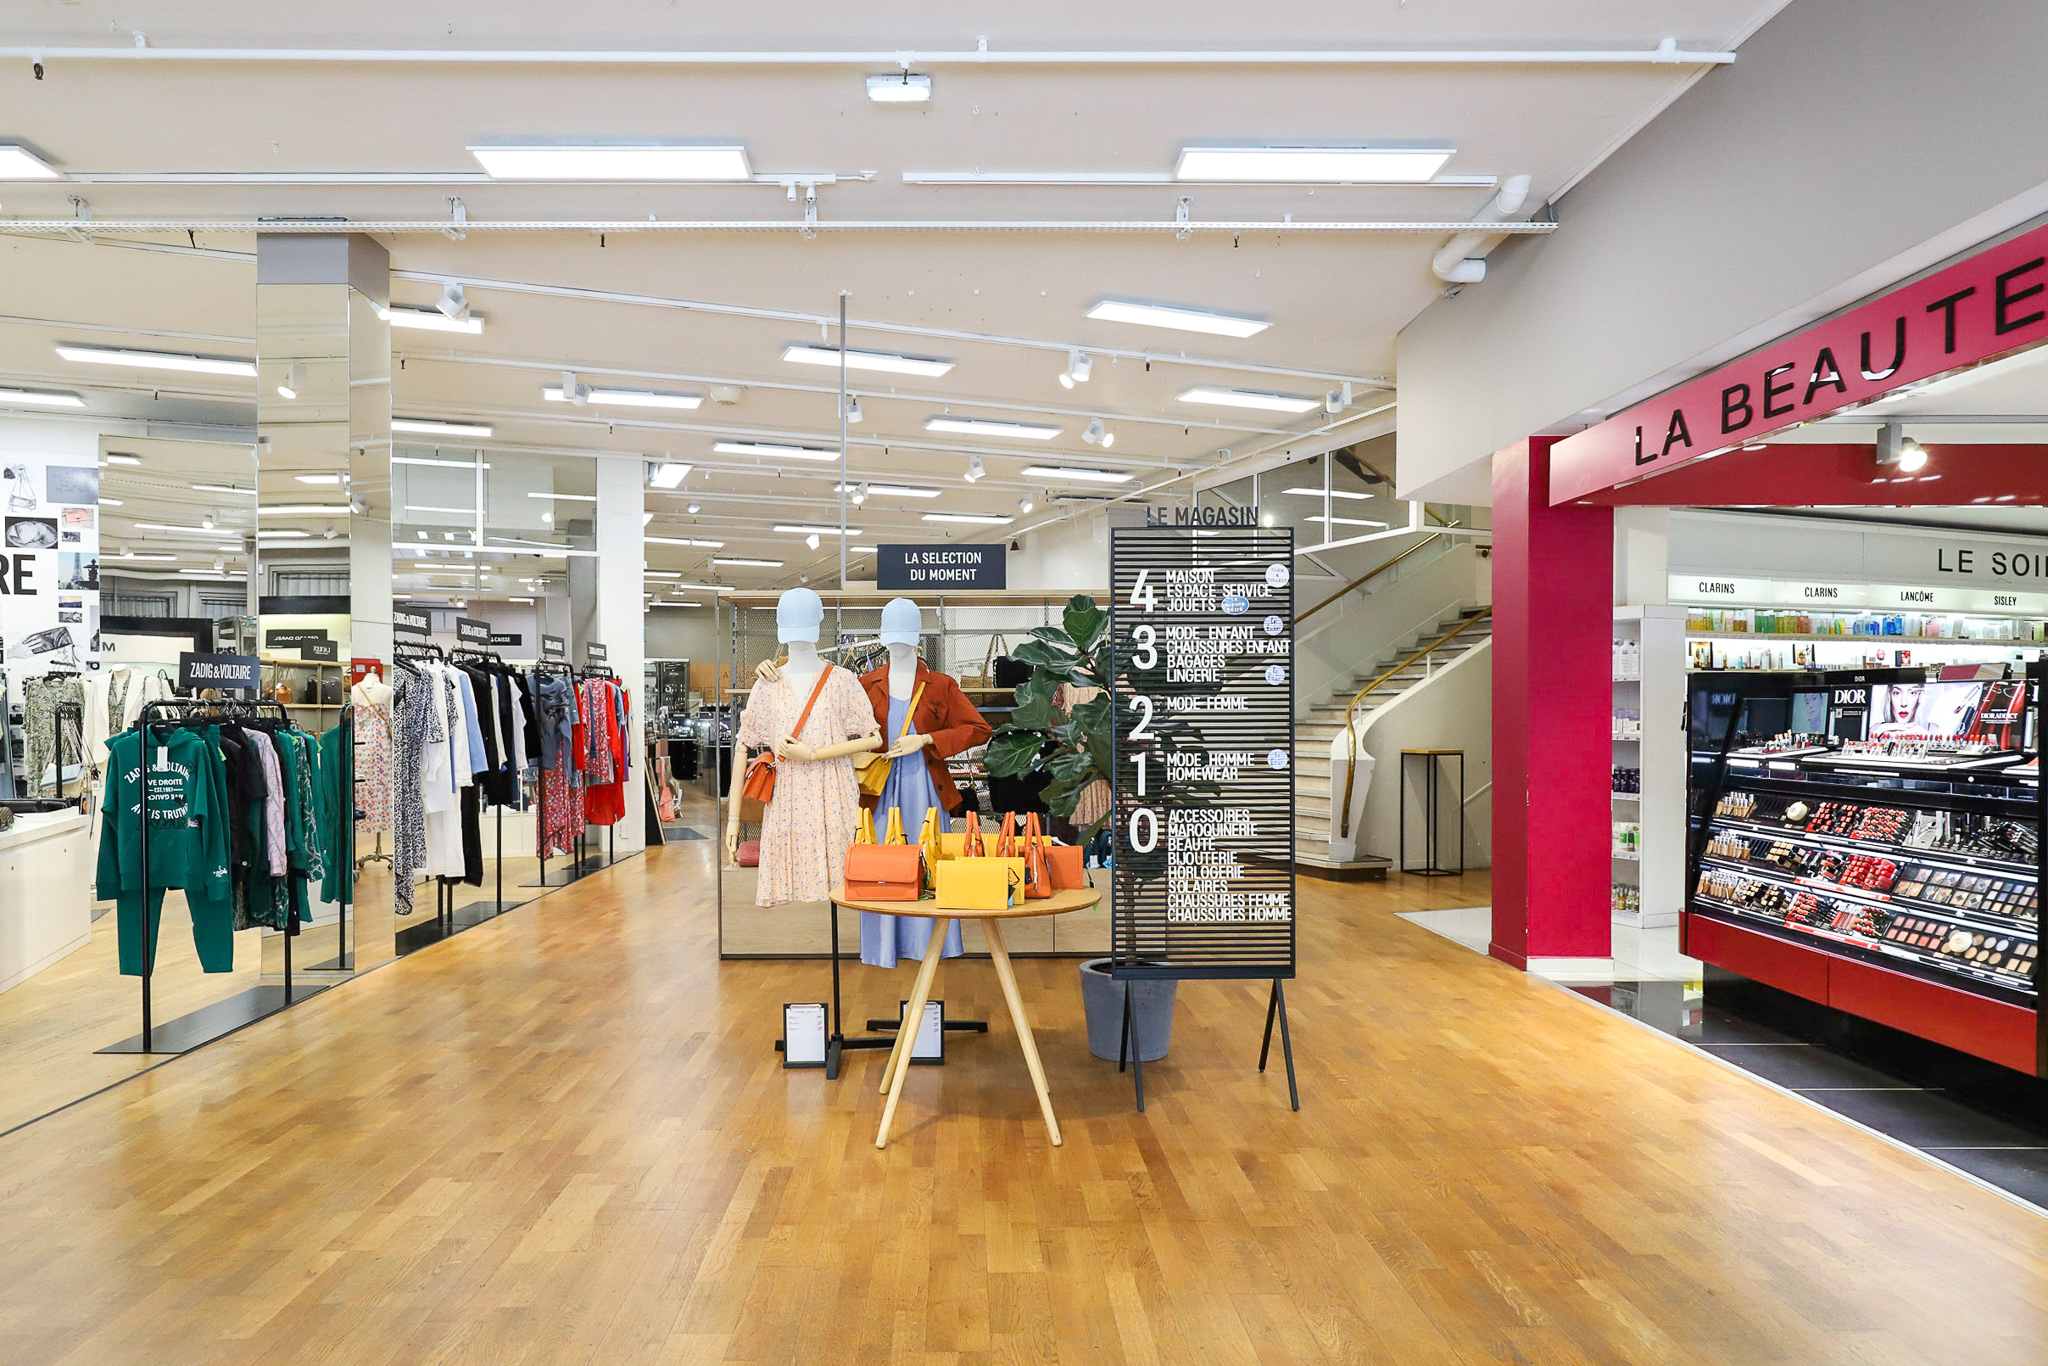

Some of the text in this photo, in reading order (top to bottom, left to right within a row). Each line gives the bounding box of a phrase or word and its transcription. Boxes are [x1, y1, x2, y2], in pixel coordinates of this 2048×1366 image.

[1635, 257, 2046, 466] LA BEAUTE
[1146, 506, 1258, 525] LE MAGASIN
[904, 552, 982, 564] LA SELECTION
[1938, 548, 2048, 577] LE SOI
[910, 568, 977, 581] DU MOMENT
[1166, 569, 1215, 584] MAISON
[1129, 569, 1158, 613] 4
[1167, 583, 1273, 598] ESPACE SERVICE
[1699, 582, 1735, 594] CLARINS
[1804, 586, 1838, 598] CLARINS
[1900, 590, 1934, 602] LANCÔME
[1994, 595, 2017, 606] SISLEY
[1167, 598, 1217, 612] JOUETS
[1166, 626, 1200, 640] MODE
[1209, 626, 1255, 640] ENFANT
[1131, 624, 1158, 670] 3
[1166, 640, 1291, 654] CHAUSSURES ENFANT
[1167, 654, 1226, 668] BAGAGES
[190, 662, 251, 680] ZADIG&VOLTAIRE
[1167, 668, 1221, 682] LINGERIE
[1167, 697, 1248, 710] MODE FEMME
[1834, 689, 1866, 704] DIOR
[1128, 695, 1155, 740] 2
[1167, 753, 1201, 766] MODE
[1209, 753, 1255, 766] HOMME
[1130, 752, 1146, 797] 1
[1167, 767, 1239, 780] HOMEWEAR
[151, 810, 161, 819] IS
[1169, 809, 1250, 823] ACCESSOIRES
[1129, 808, 1158, 854] 0
[1168, 823, 1258, 837] MAROQUINERIE
[1168, 851, 1238, 865] BIJOUTERIE
[1168, 866, 1245, 879] HORLOGERIE
[1169, 880, 1229, 893] SOLAIRES
[1168, 894, 1290, 907] CHAUSSURES FEMME
[1168, 908, 1292, 921] CHAUSSURES HOMME
